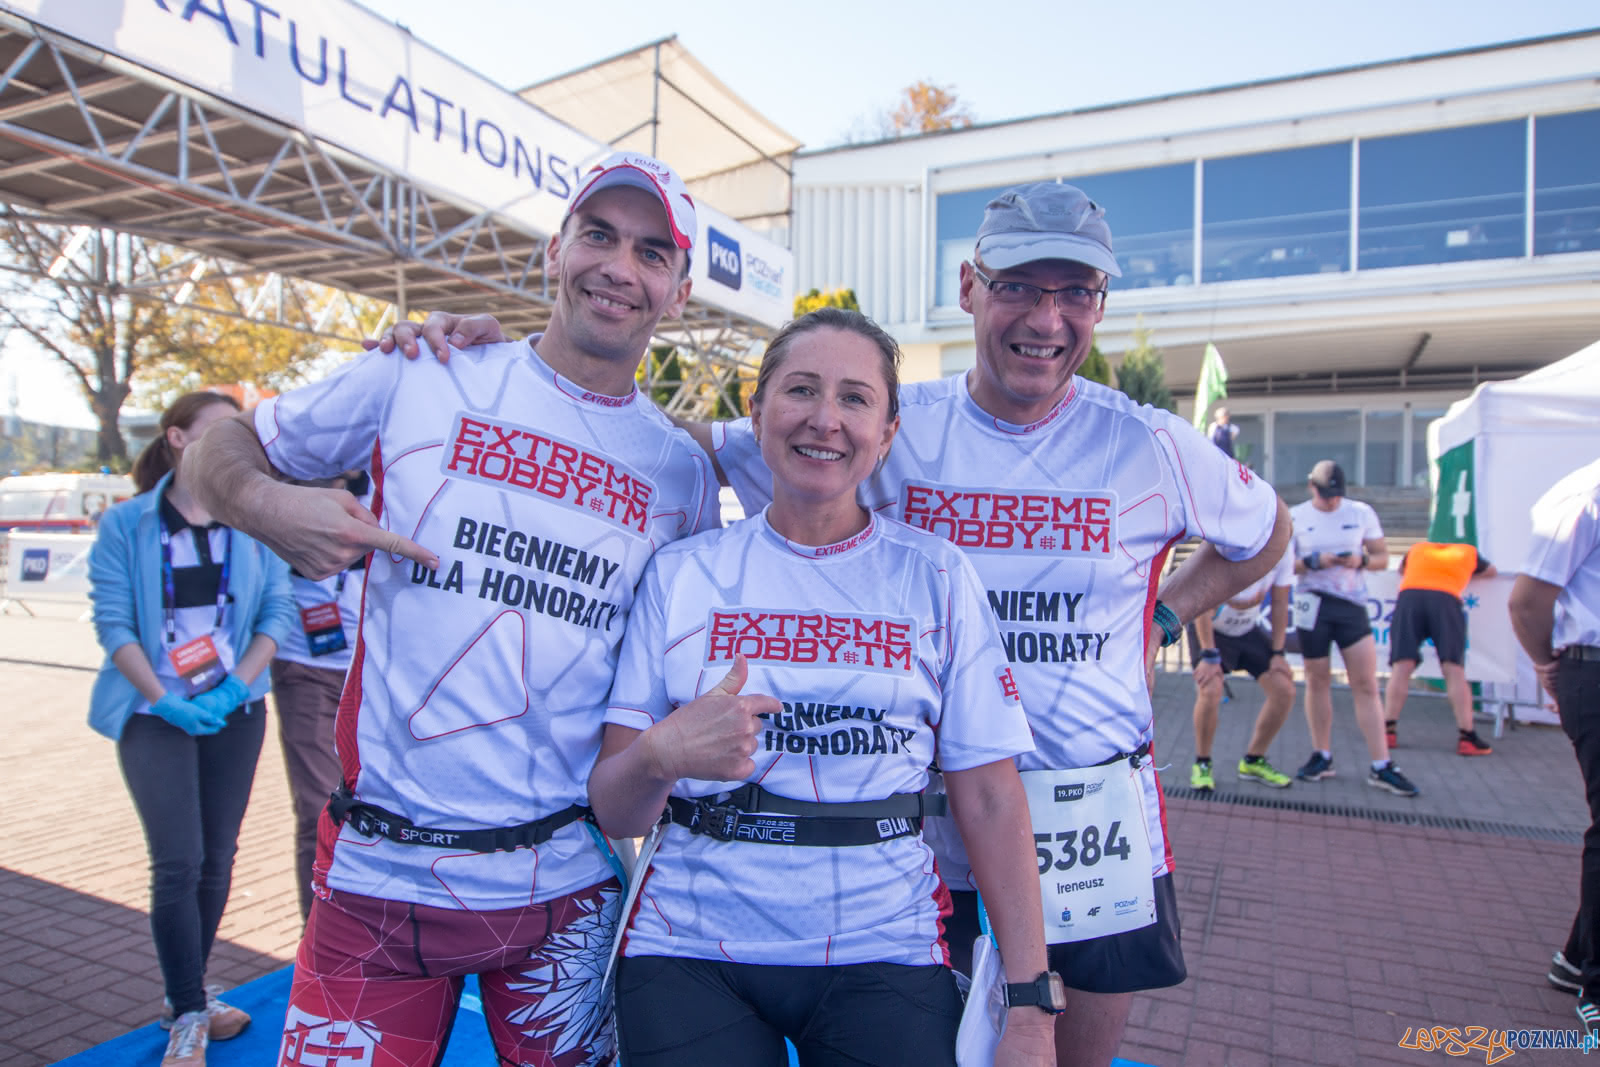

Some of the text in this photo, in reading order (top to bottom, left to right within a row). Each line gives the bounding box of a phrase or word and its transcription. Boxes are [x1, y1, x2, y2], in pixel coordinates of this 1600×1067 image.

[155, 0, 580, 200] ATULATIONS
[711, 241, 739, 275] PKO
[582, 391, 625, 408] EXTREME
[455, 417, 652, 509] EXTREME
[904, 485, 1111, 525] EXTREME
[453, 516, 620, 591] BIEGNIEMY
[815, 536, 860, 557] EXTREME
[411, 556, 620, 631] DLA HONORATY
[710, 612, 912, 647] EXTREME
[757, 701, 887, 732] GNIEMY
[765, 725, 916, 756] HONORATY
[1068, 788, 1083, 797] PKO
[1033, 821, 1131, 875] 5384
[1056, 877, 1105, 895] Ireneusz
